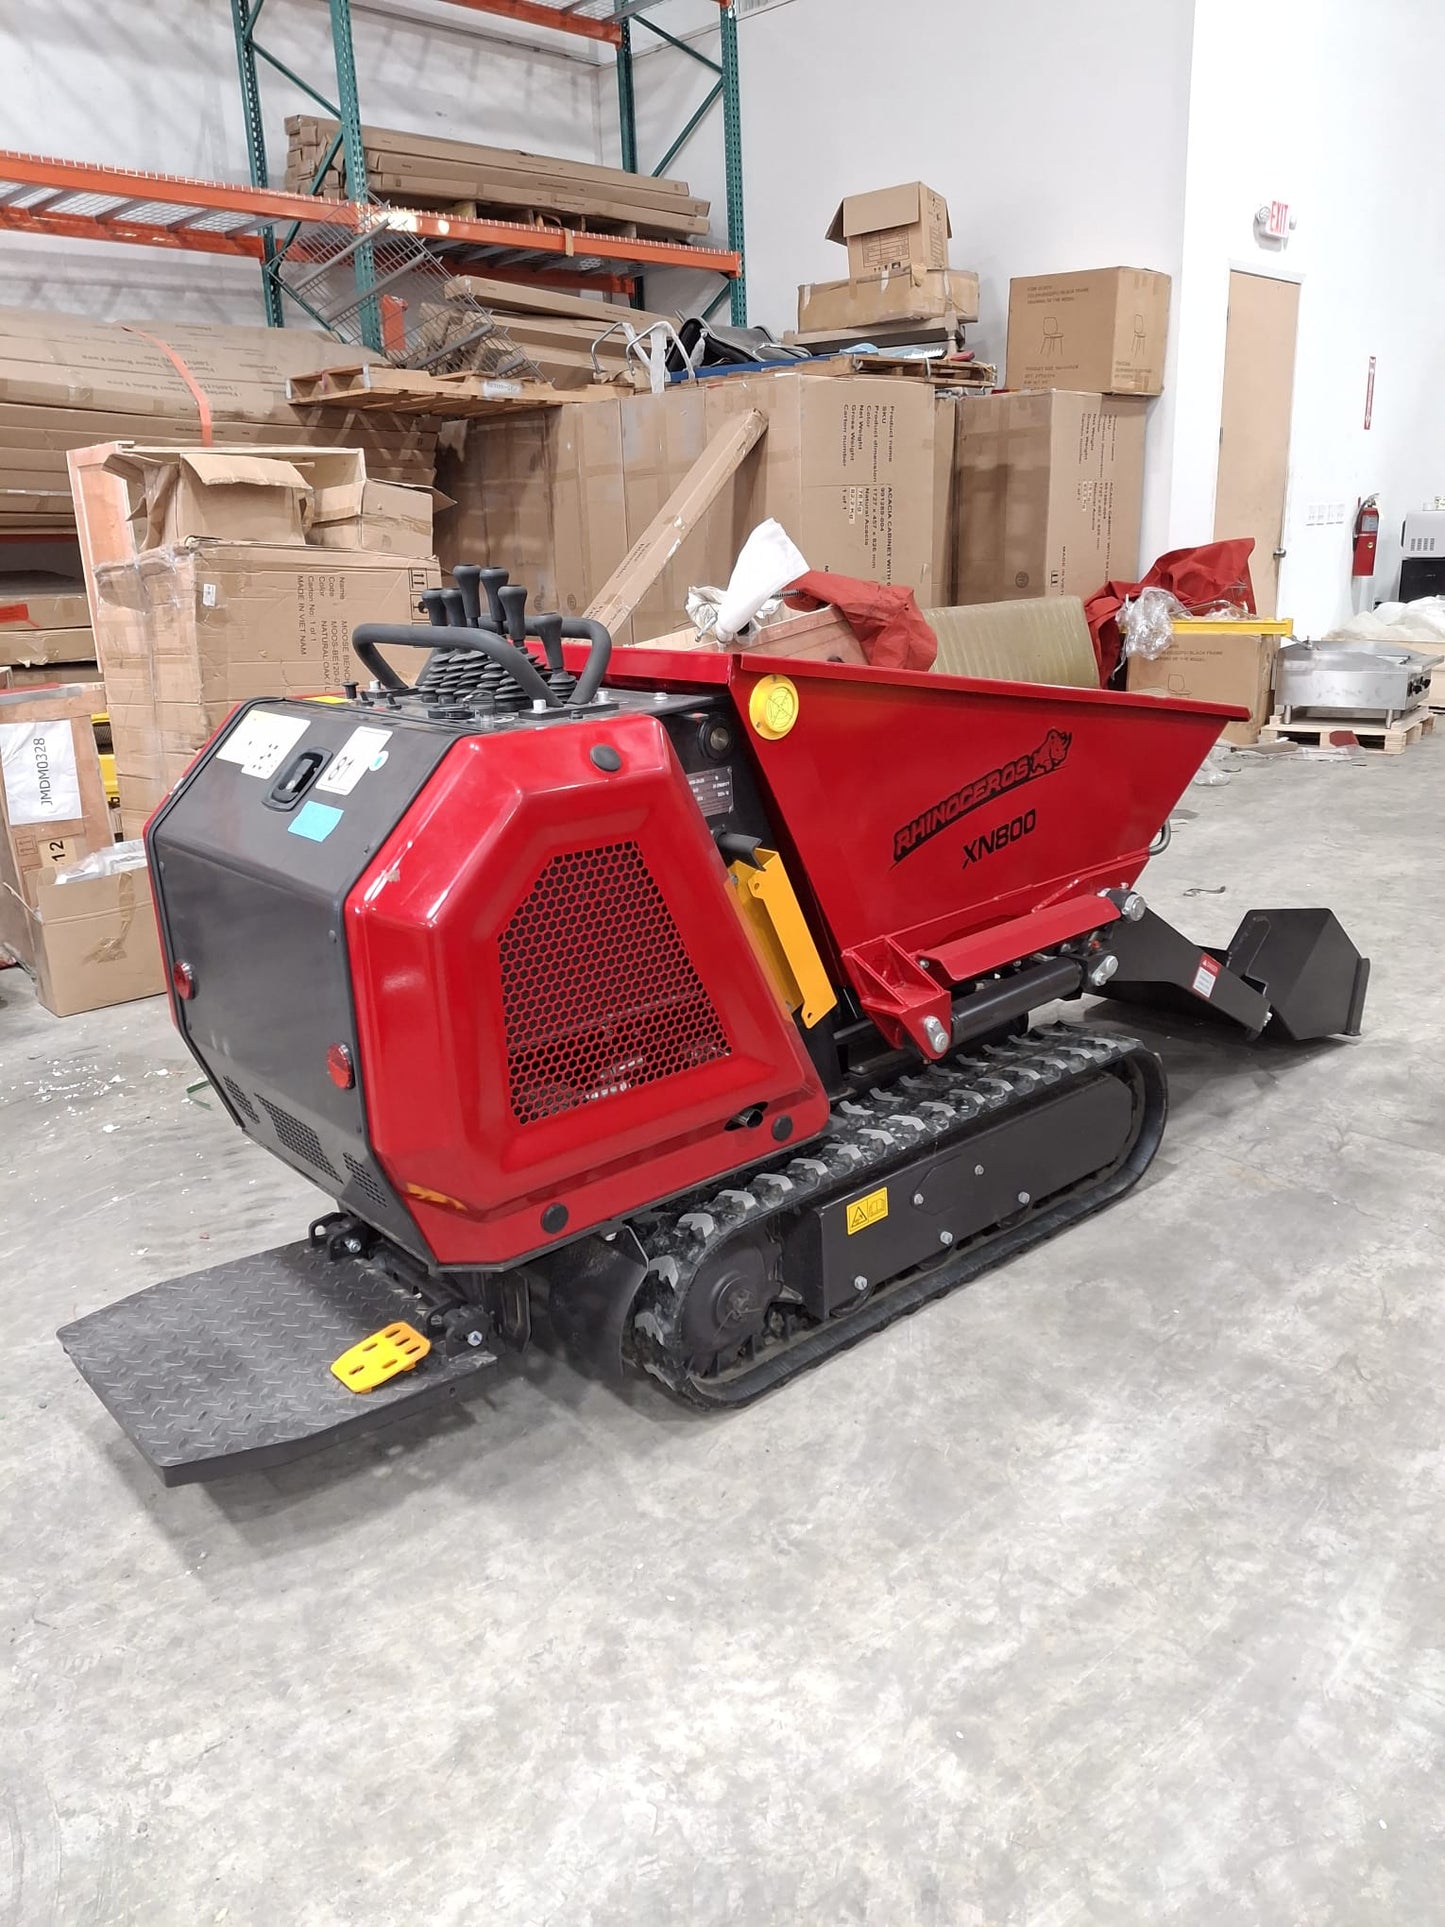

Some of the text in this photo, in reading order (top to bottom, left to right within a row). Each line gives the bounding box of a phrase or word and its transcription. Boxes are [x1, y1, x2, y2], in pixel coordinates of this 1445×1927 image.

[1270, 201, 1288, 235] EXIT
[299, 603, 305, 611] IN
[310, 627, 316, 635] of
[341, 621, 349, 652] MOOSE
[33, 737, 53, 806] JMDM0328
[49, 840, 66, 862] 12
[962, 808, 1036, 870] XN800
